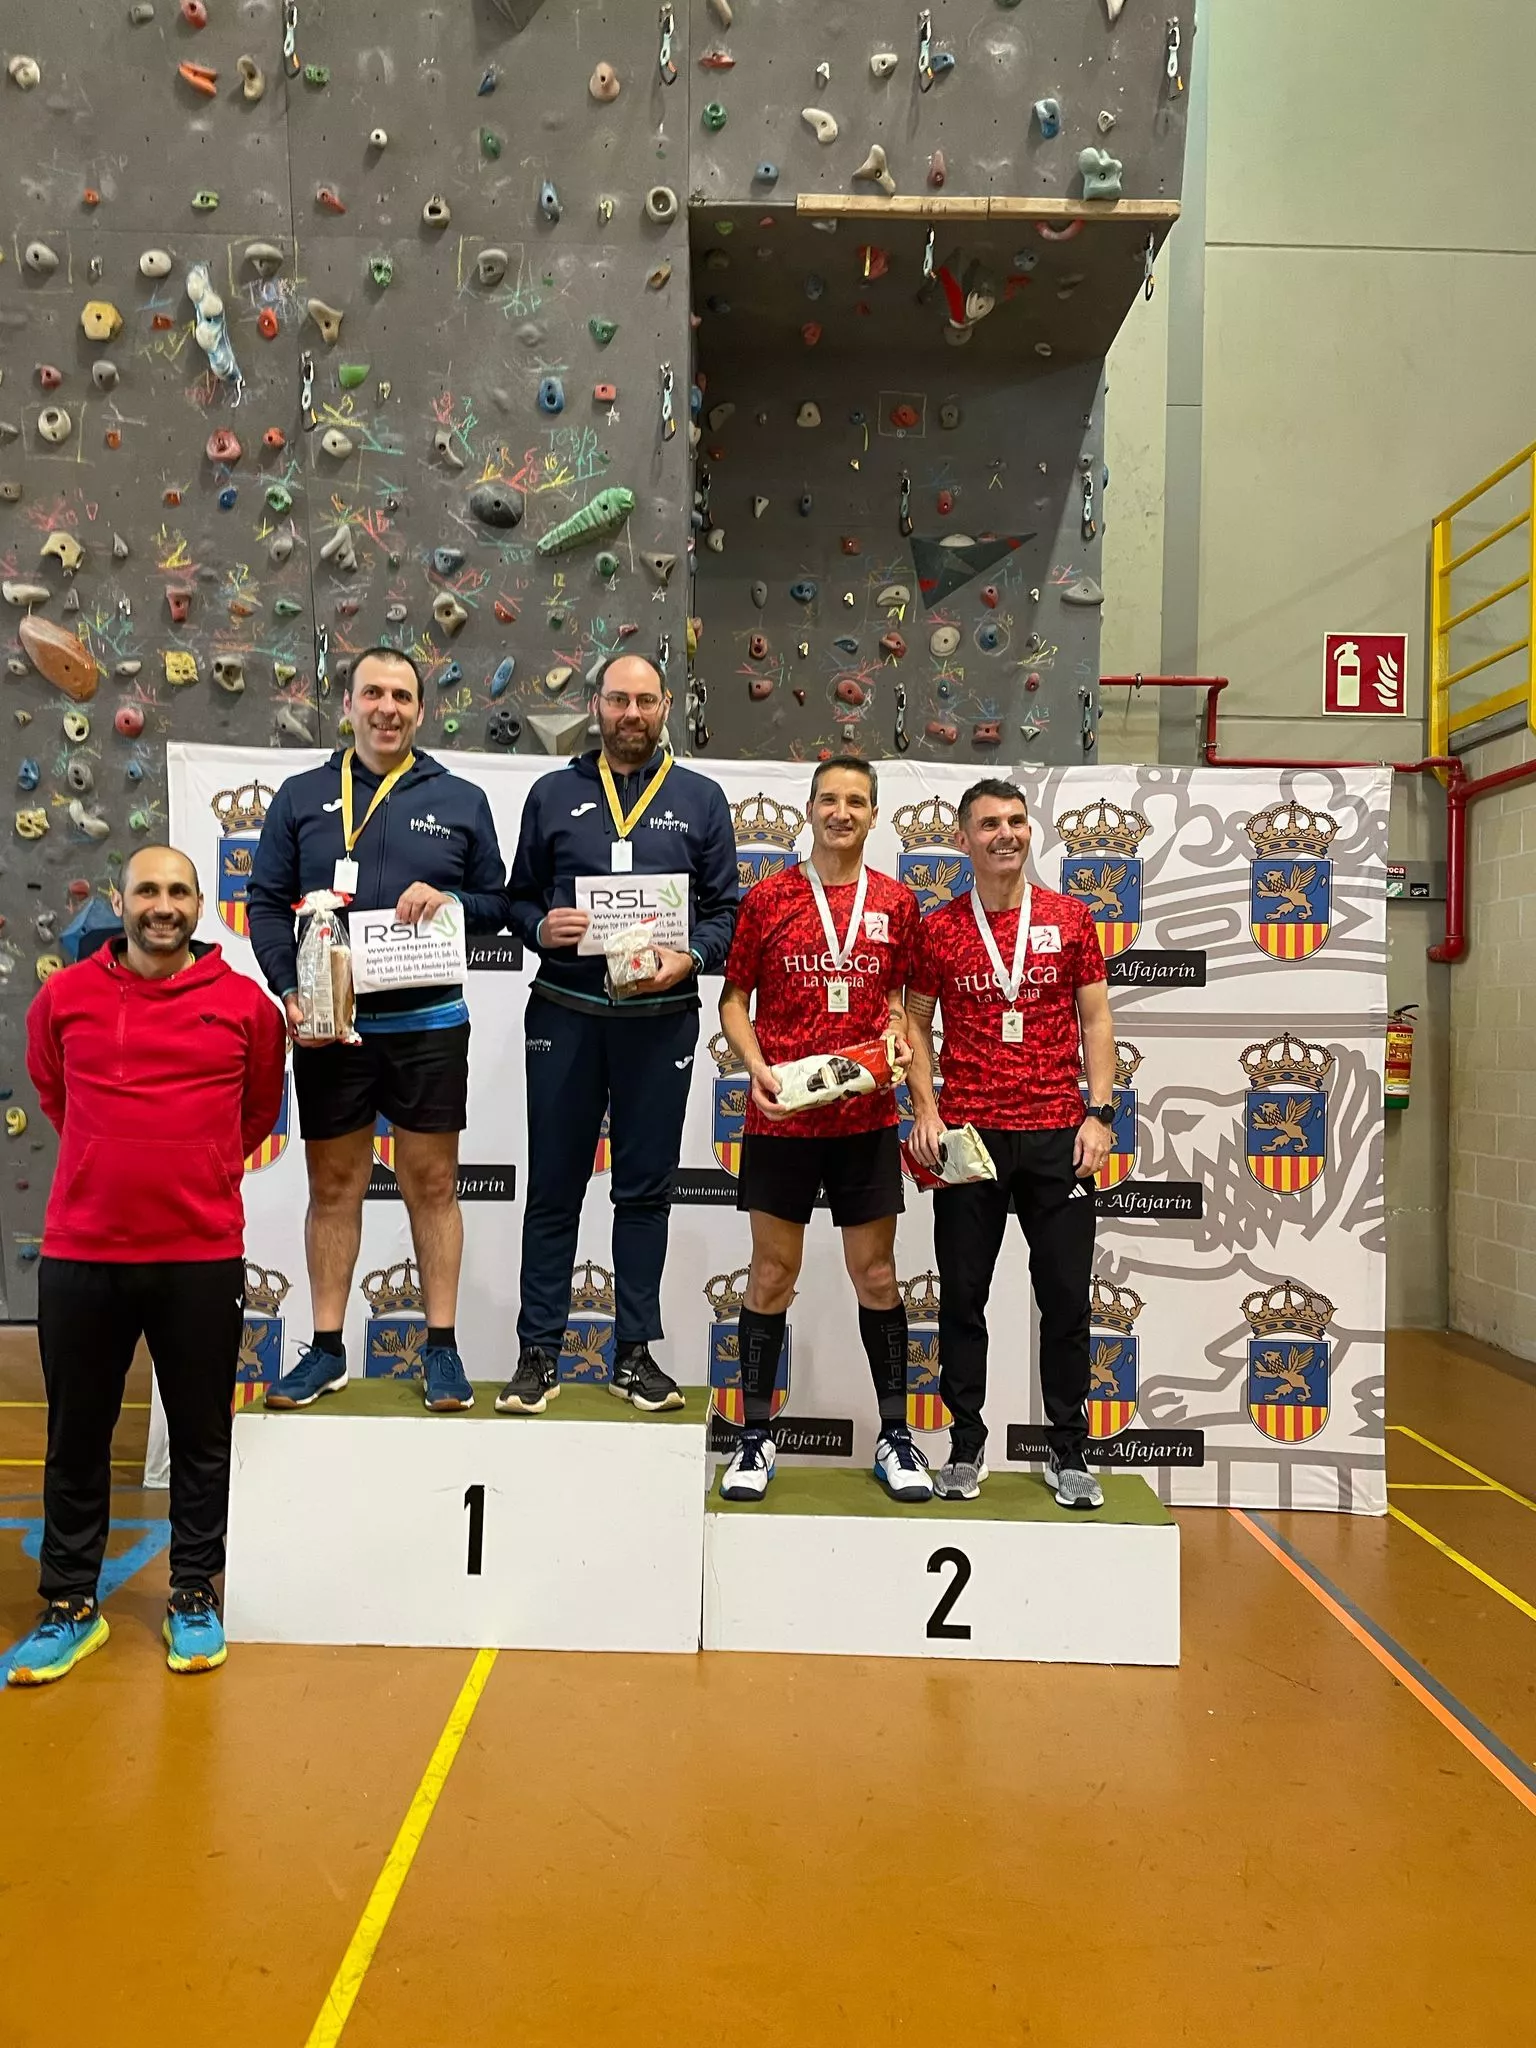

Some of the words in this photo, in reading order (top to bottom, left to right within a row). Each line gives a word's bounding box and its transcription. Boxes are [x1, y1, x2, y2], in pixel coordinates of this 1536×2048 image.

[590, 889, 657, 909] RSL
[364, 920, 432, 944] RSL
[467, 946, 514, 967] jarín
[1111, 961, 1197, 982] Alfajarín
[1107, 1192, 1193, 1214] Alfajarín
[770, 1428, 842, 1450] lfajarín
[1108, 1440, 1194, 1462] Alfajarín
[464, 1484, 485, 1576] 1
[926, 1546, 972, 1640] 2
